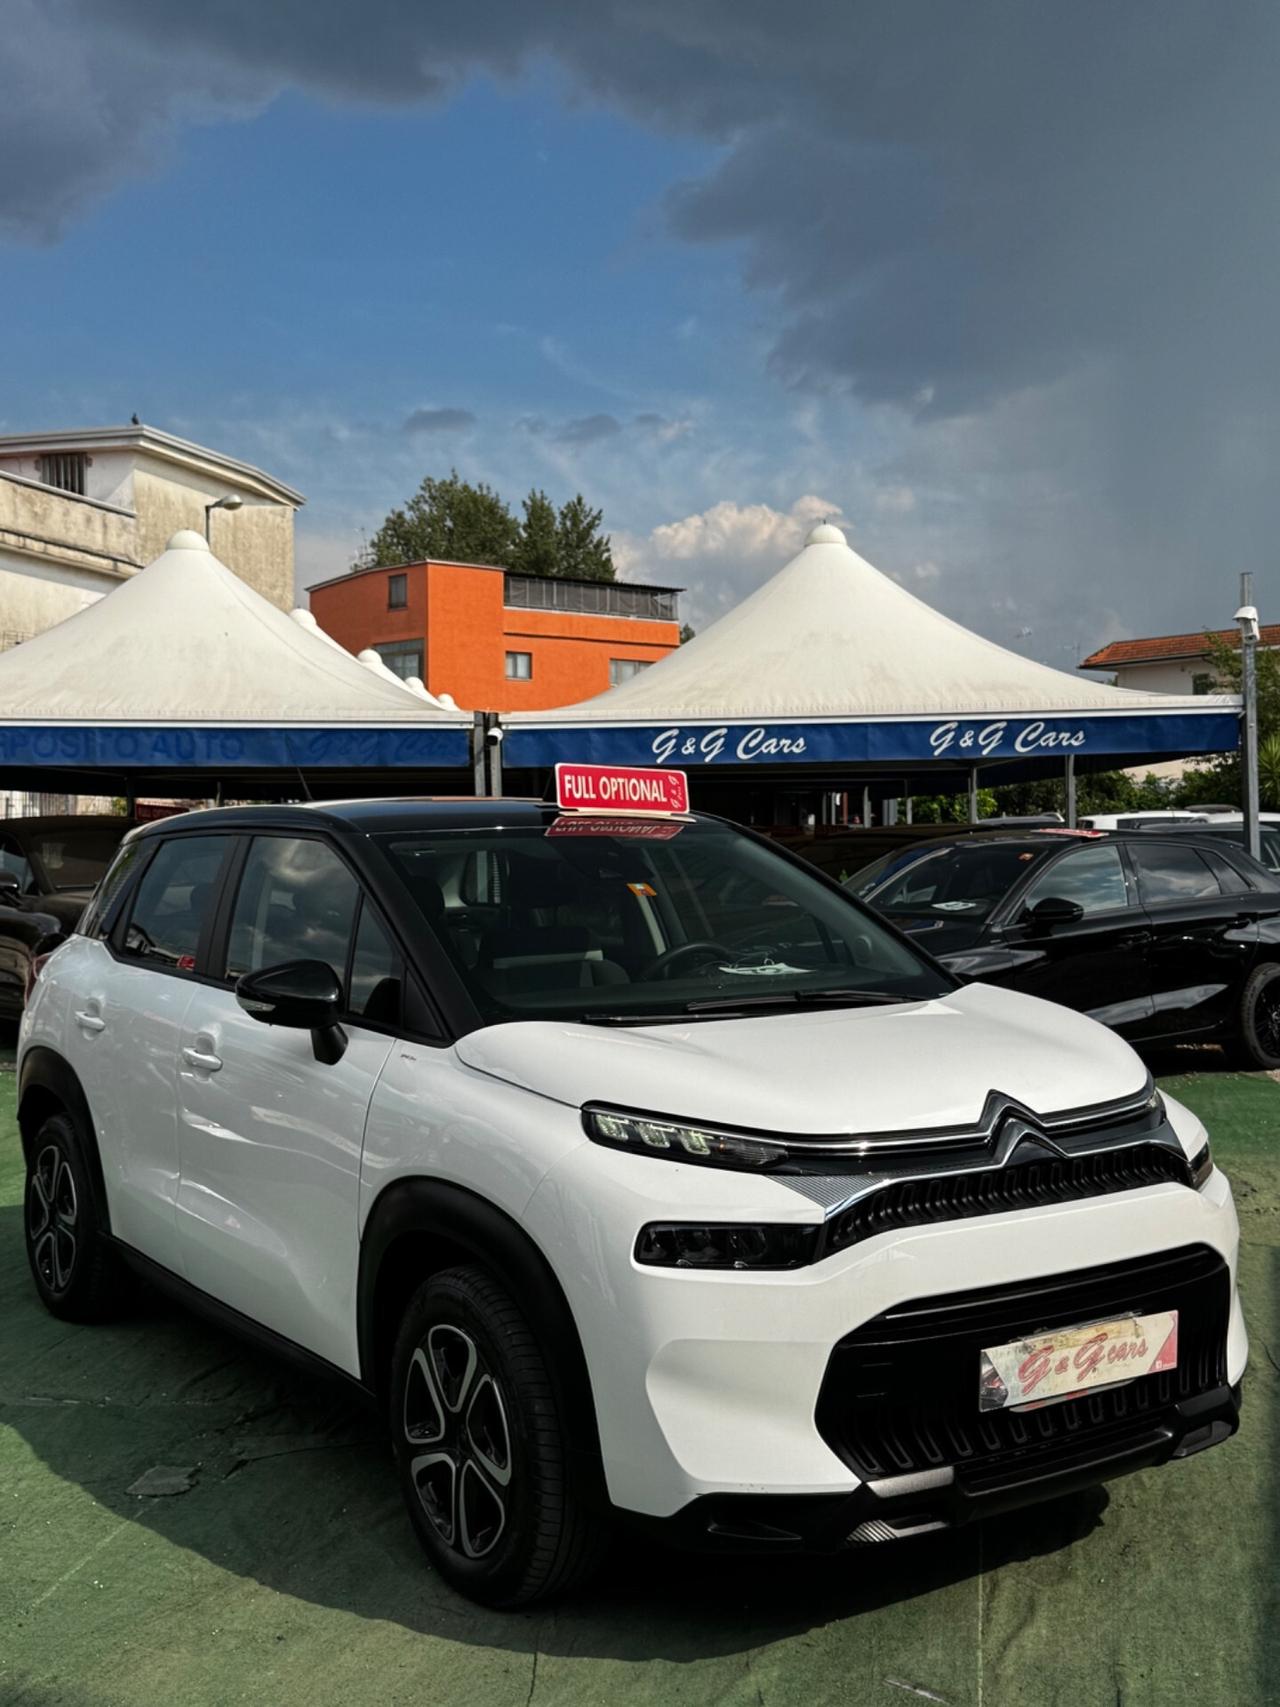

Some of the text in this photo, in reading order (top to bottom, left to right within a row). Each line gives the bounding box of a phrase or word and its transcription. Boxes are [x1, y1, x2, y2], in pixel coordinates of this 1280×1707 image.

[736, 727, 807, 760] Cars
[1014, 721, 1085, 753] Cars
[564, 774, 597, 800] FULL
[599, 776, 668, 802] OPTIONAL
